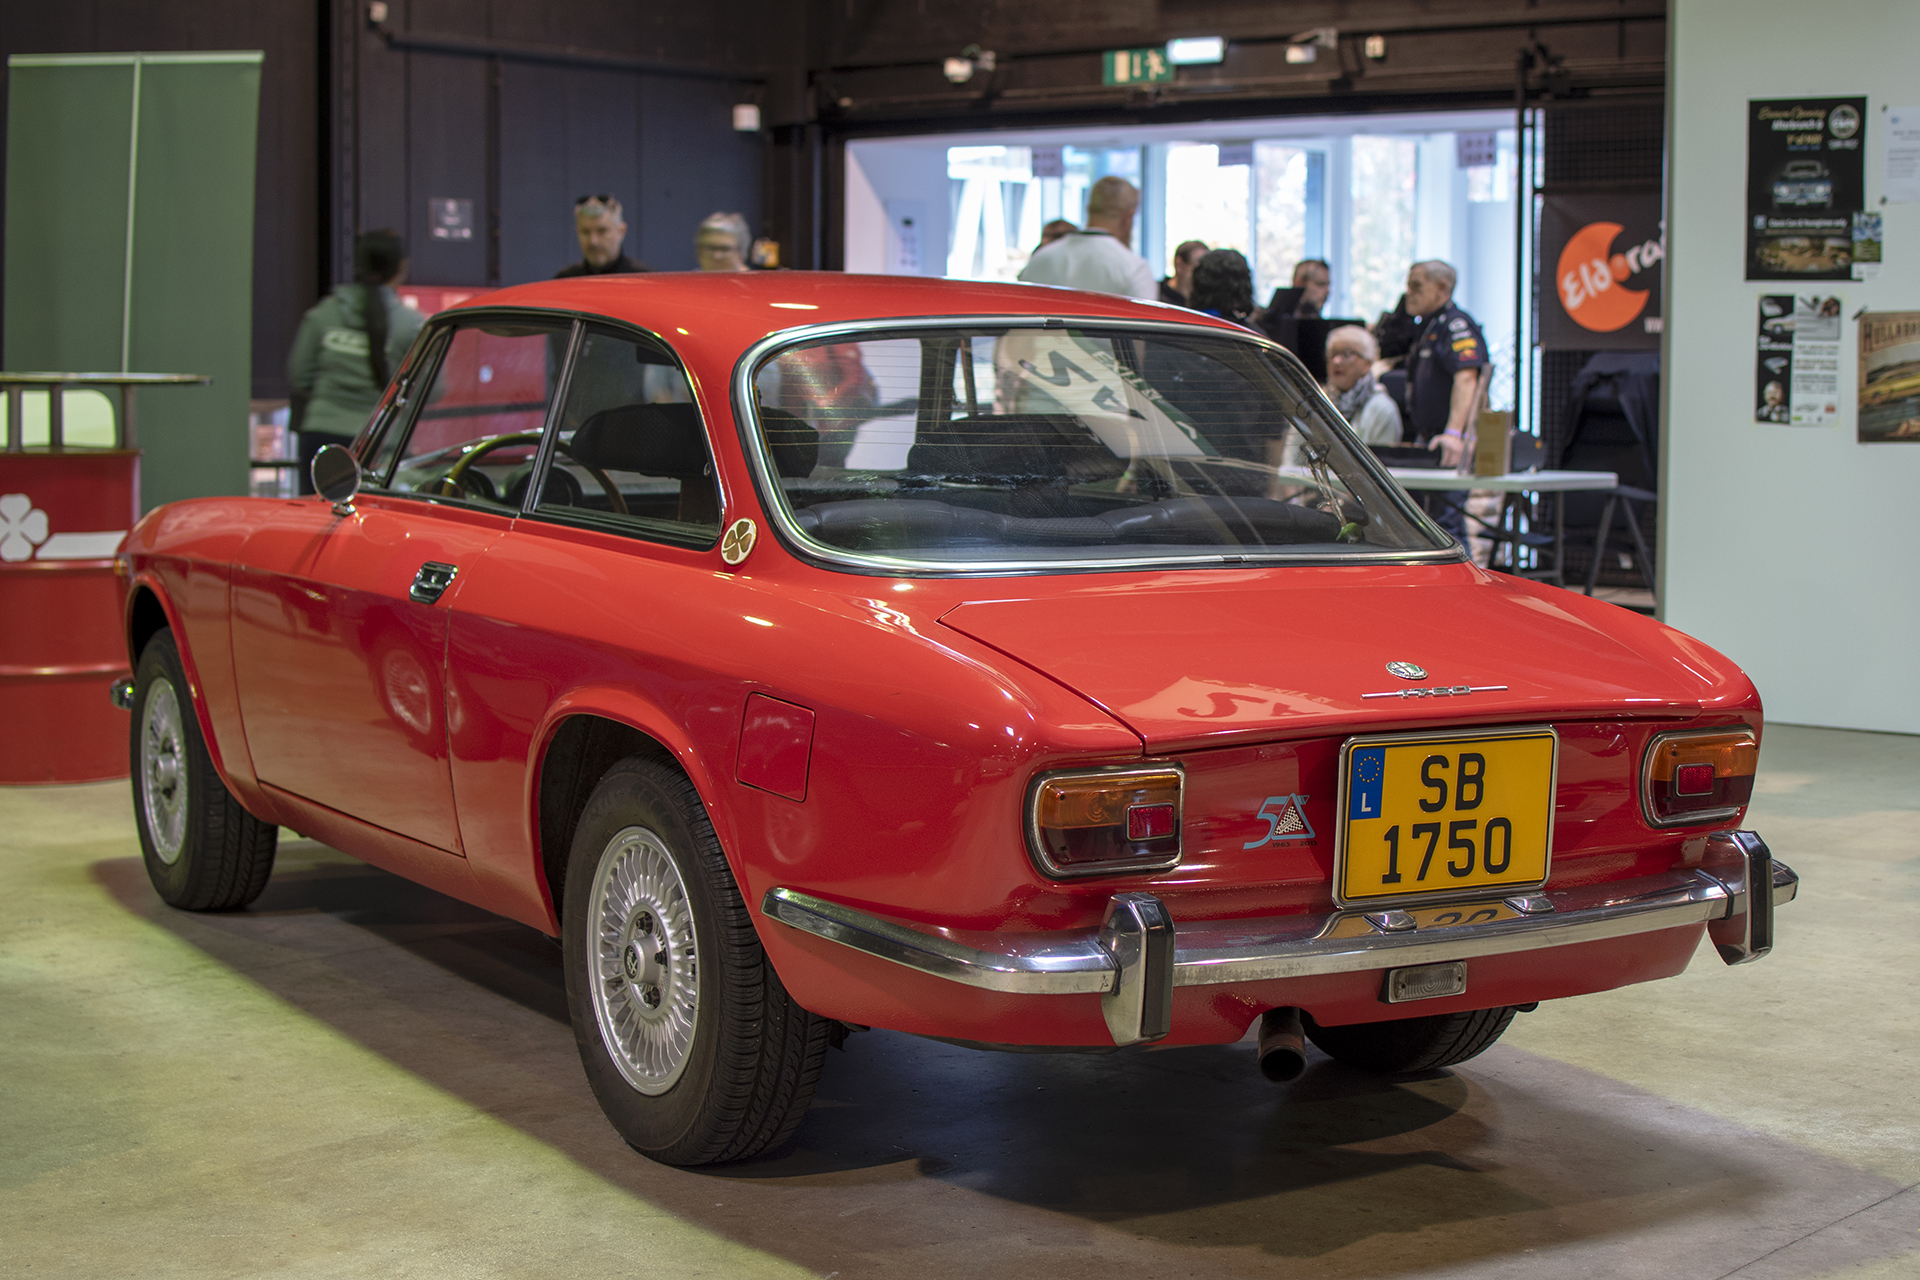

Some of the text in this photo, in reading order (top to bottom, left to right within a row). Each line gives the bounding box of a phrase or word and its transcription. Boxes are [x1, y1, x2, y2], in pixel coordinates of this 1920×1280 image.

[1399, 685, 1471, 699] 1750
[1361, 792, 1372, 812] L
[1418, 752, 1486, 813] SB
[1381, 817, 1512, 884] 1750
